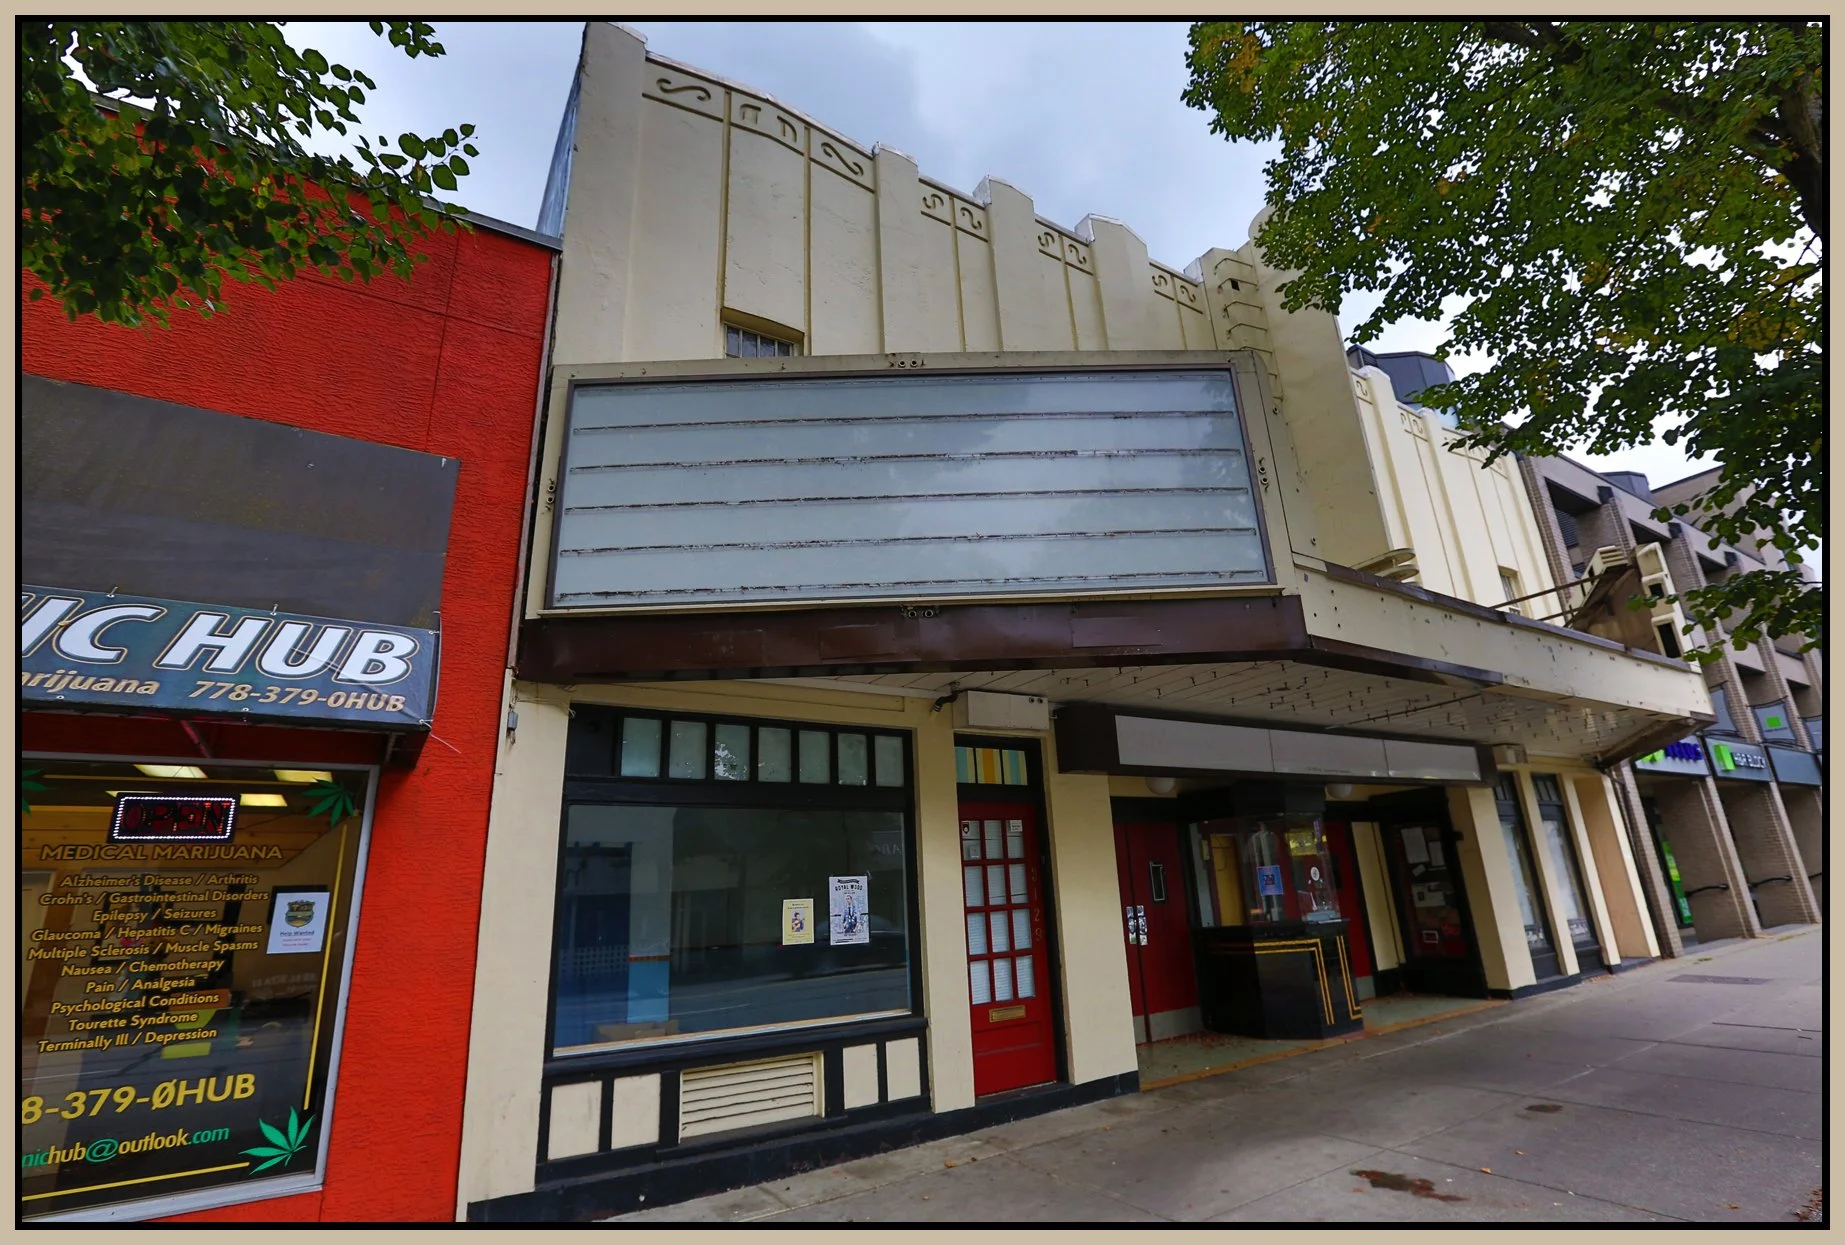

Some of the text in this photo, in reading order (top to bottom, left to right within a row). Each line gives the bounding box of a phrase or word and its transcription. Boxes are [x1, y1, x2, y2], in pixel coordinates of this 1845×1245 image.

[154, 611, 419, 685] HUB
[188, 681, 406, 711] 778-379-0HUB
[120, 801, 232, 834] OPEN
[40, 845, 283, 861] MEDICAL MARIJUANA
[60, 876, 140, 888] Alzheimer's
[143, 875, 194, 886] Disease
[207, 874, 258, 885] Arthritis
[39, 893, 93, 905] Crohn's
[109, 891, 210, 904] Gastrointestinal
[212, 890, 269, 901] Disorders
[92, 910, 149, 924] Epilepsy
[164, 908, 217, 920] Seizures
[31, 930, 101, 942] Glaucoma
[117, 926, 177, 939] Hepatitis
[179, 926, 190, 937] C
[205, 924, 263, 937] Migraines
[28, 948, 87, 961] Multiple
[90, 946, 150, 958] Sclerosis
[165, 942, 210, 954] Muscle
[212, 940, 258, 953] Spasms
[61, 965, 112, 977] Nausea
[129, 959, 225, 973] Chemotherapy
[85, 982, 115, 993] Pain
[131, 977, 196, 992] Analgesia
[50, 994, 220, 1015] Psychological Conditions
[68, 1013, 199, 1031] Tourette Syndrome
[38, 1037, 112, 1053] Terminally
[115, 1033, 129, 1045] Ill
[144, 1028, 217, 1044] Depression
